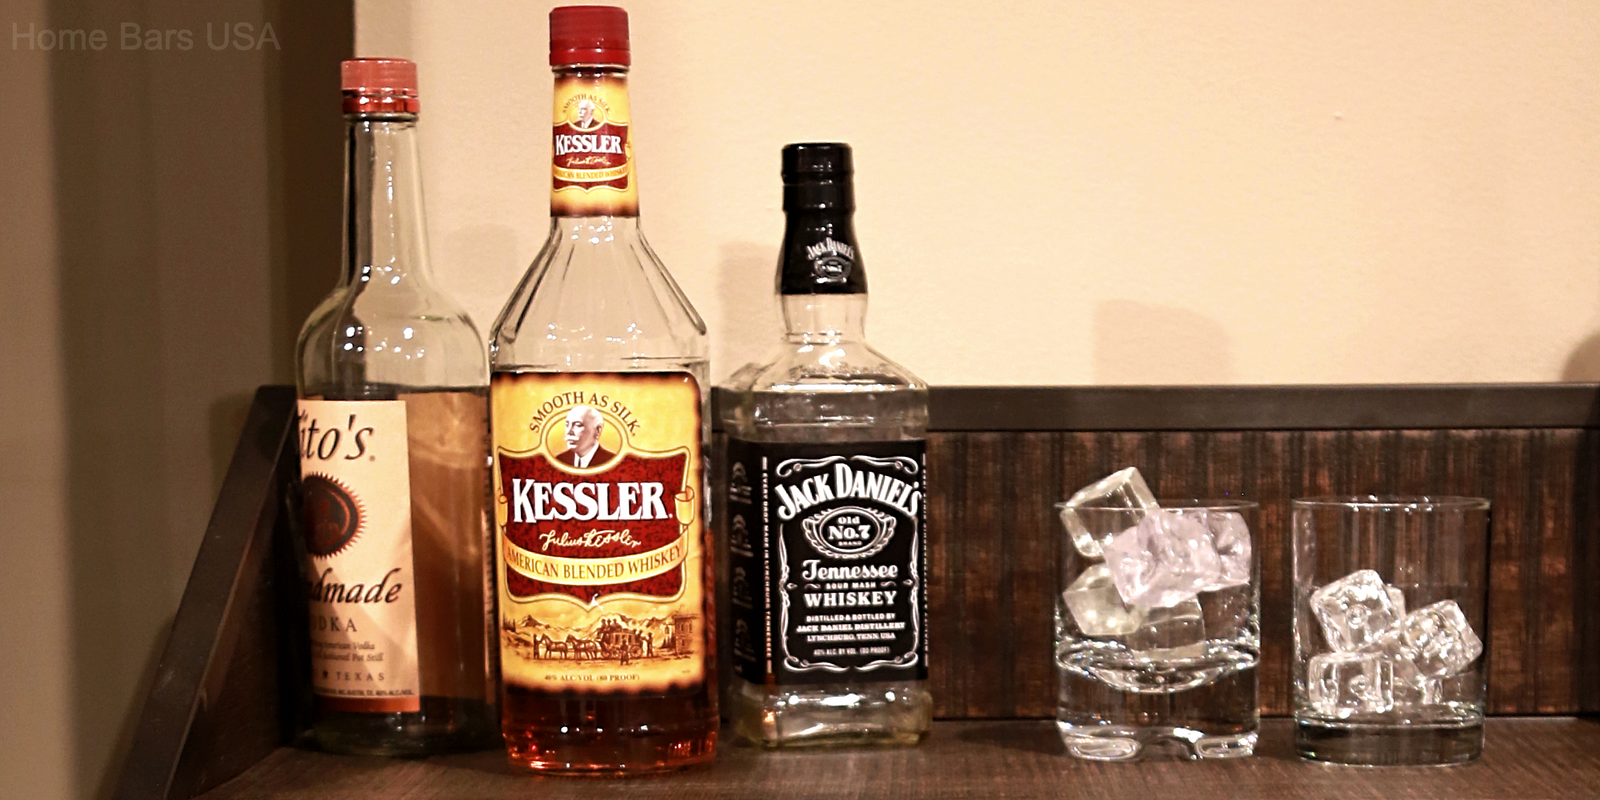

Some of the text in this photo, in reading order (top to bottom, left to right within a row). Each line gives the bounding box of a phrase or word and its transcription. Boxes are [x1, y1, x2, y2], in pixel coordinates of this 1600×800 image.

[556, 134, 623, 155] KESSLER
[529, 391, 584, 433] SMOOTH
[589, 393, 609, 407] AS
[775, 463, 923, 520] JACK DANIEL'S
[837, 516, 860, 525] Old
[507, 545, 682, 580] AMERICAN BLENDED WHISKEY
[764, 549, 770, 559] IN
[802, 559, 898, 580] Tennessee
[825, 581, 876, 590] SOUR MASH
[804, 590, 897, 607] WHISKEY
[796, 622, 906, 633] JACK DANIEL DISTILLERY
[336, 671, 385, 681] TEXAS
